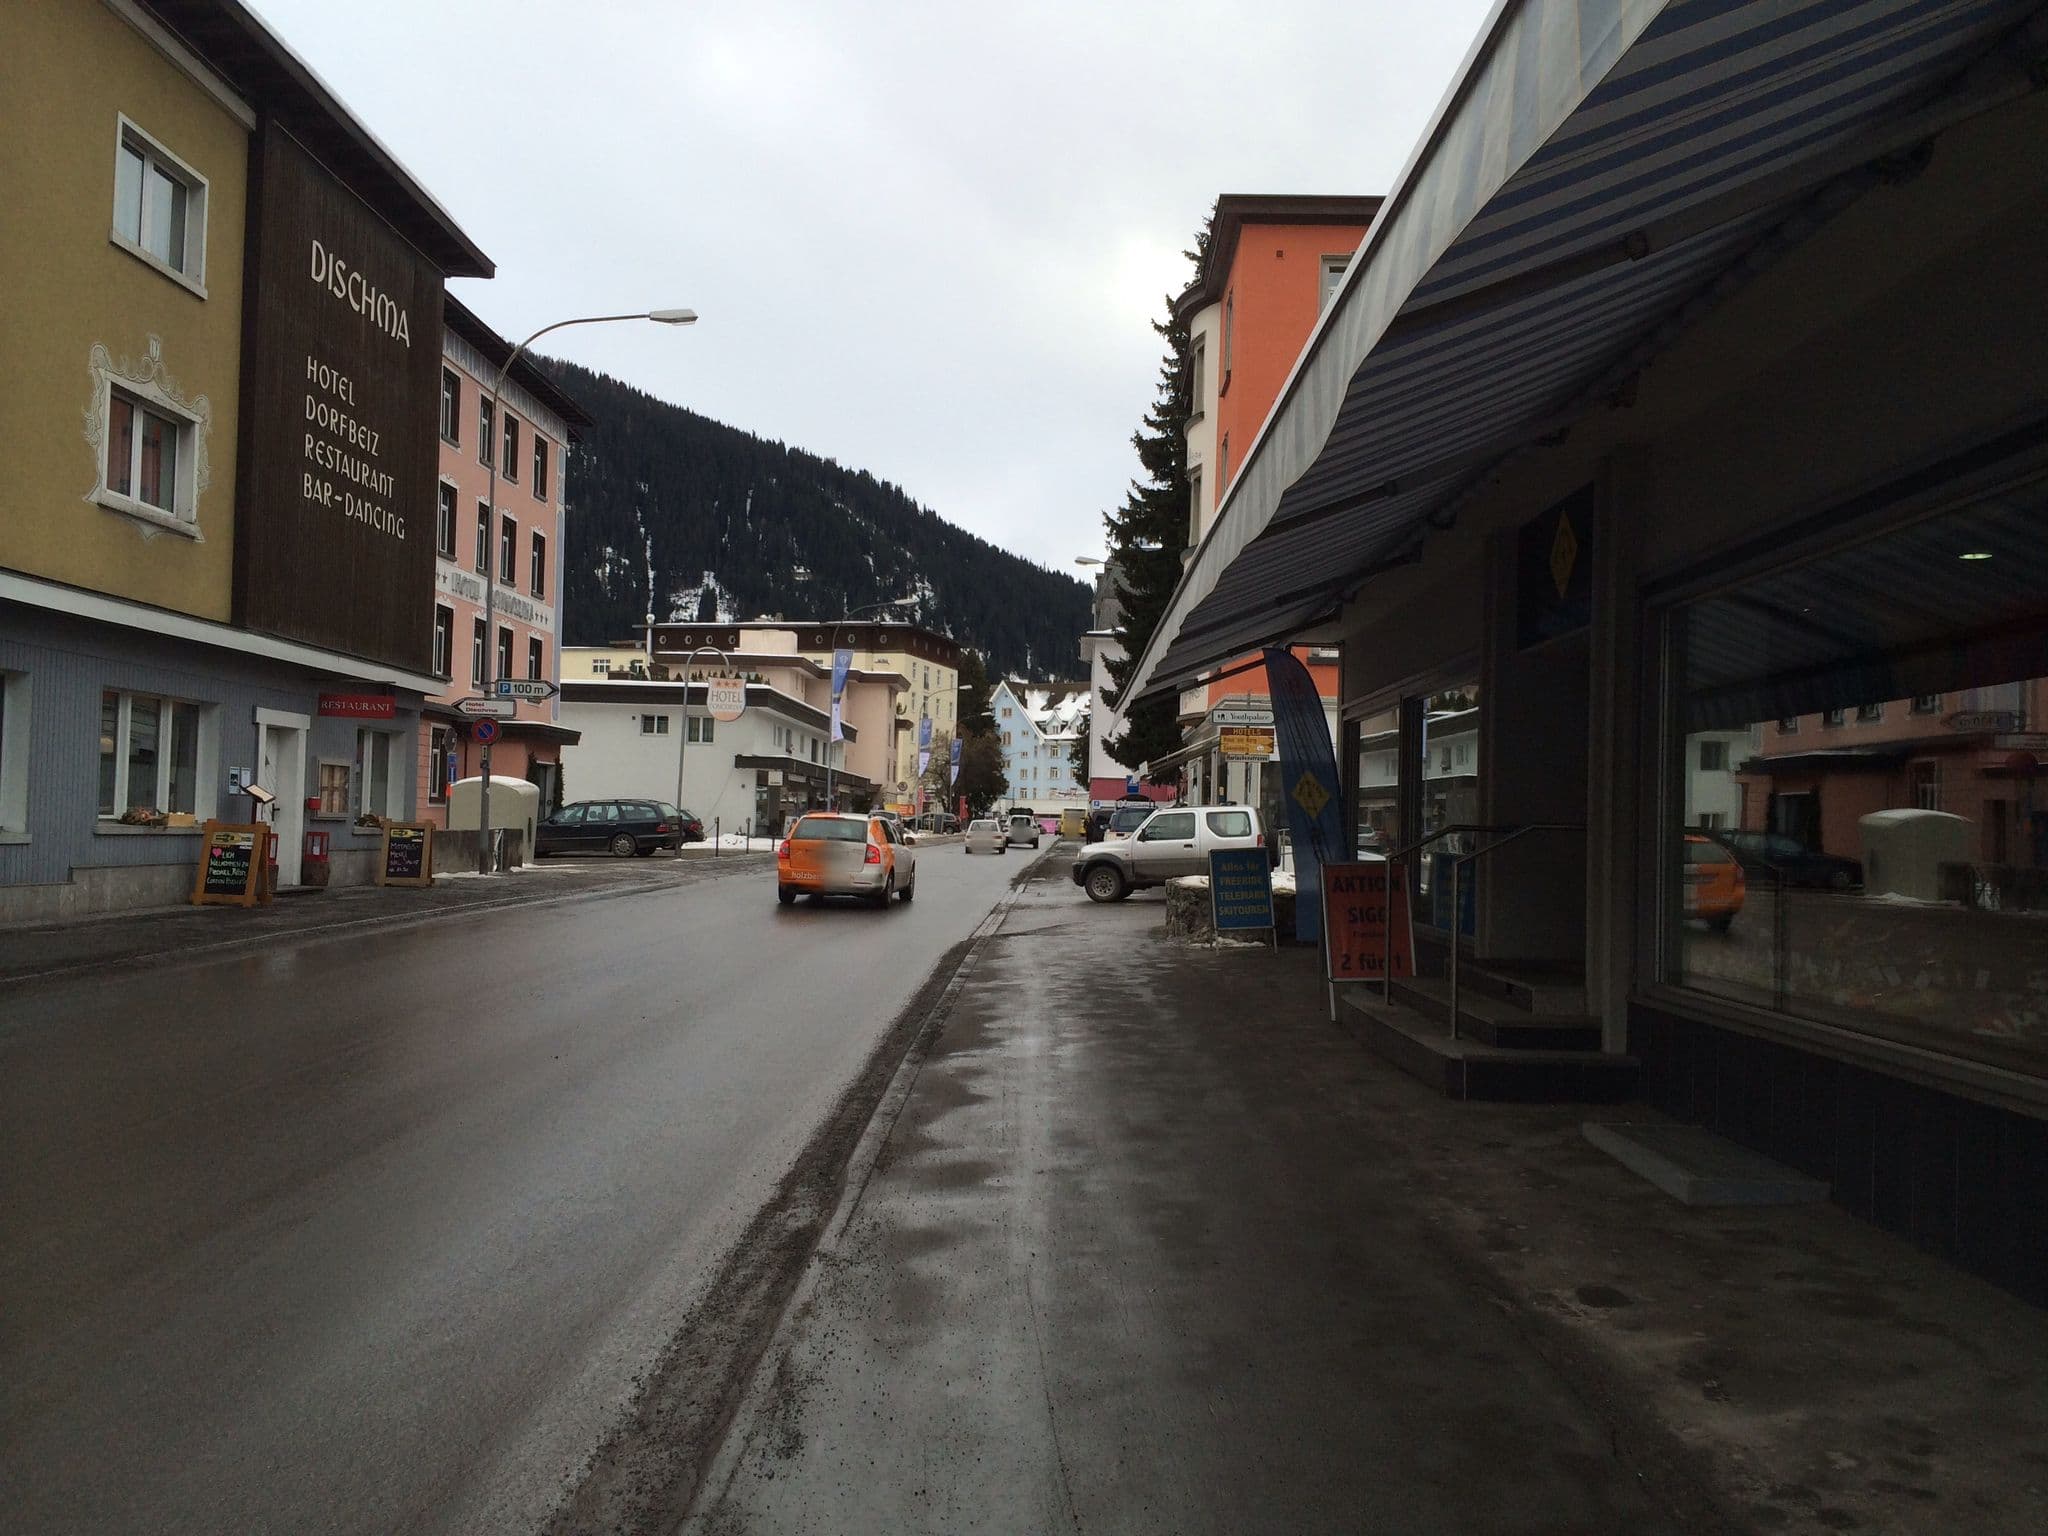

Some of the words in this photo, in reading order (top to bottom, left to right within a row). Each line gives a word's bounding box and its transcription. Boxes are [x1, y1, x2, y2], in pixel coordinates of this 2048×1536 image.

[311, 240, 410, 348] DISCHMA
[307, 355, 356, 406] HOTEL
[305, 395, 380, 457] DORFBEIZ
[305, 434, 395, 499] RESTAURANT
[303, 473, 406, 540] BAR-DANCING
[514, 684, 532, 694] 100
[534, 686, 544, 694] m
[711, 690, 743, 703] HOTEL
[321, 701, 391, 712] RESTAURANT
[1232, 728, 1262, 736] HOTELS
[1332, 876, 1401, 893] AKTION
[1342, 953, 1352, 971] 2
